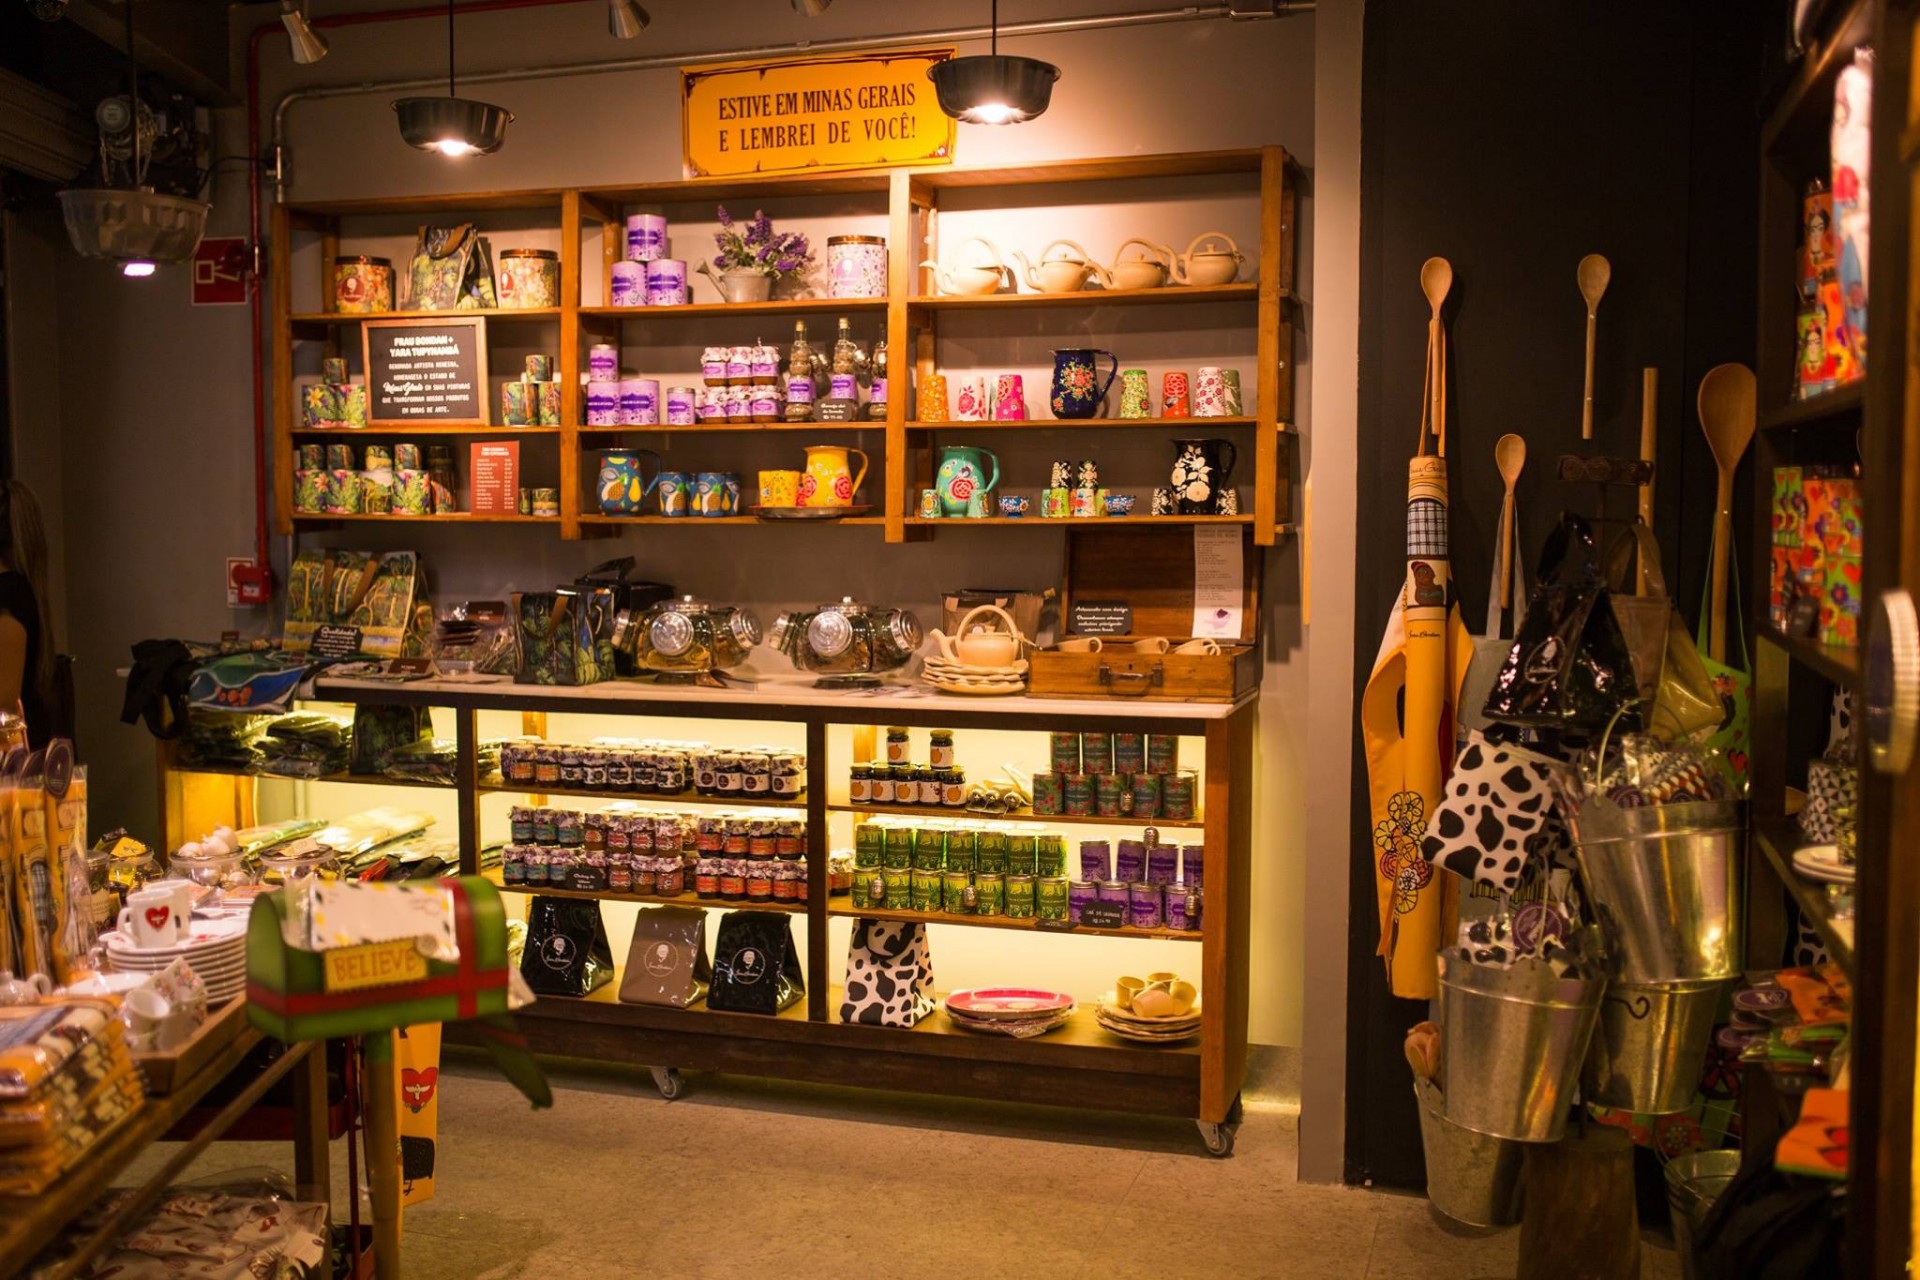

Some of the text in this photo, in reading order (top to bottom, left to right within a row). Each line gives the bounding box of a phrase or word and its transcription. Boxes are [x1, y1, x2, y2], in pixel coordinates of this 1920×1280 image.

[719, 83, 916, 121] ESTIVE EM MINAS GERAIS
[719, 112, 916, 152] E LEMBREI DE VOCÊ!
[389, 348, 412, 357] YARA
[394, 337, 414, 346] FRAU
[334, 948, 417, 983] BELIEVE
